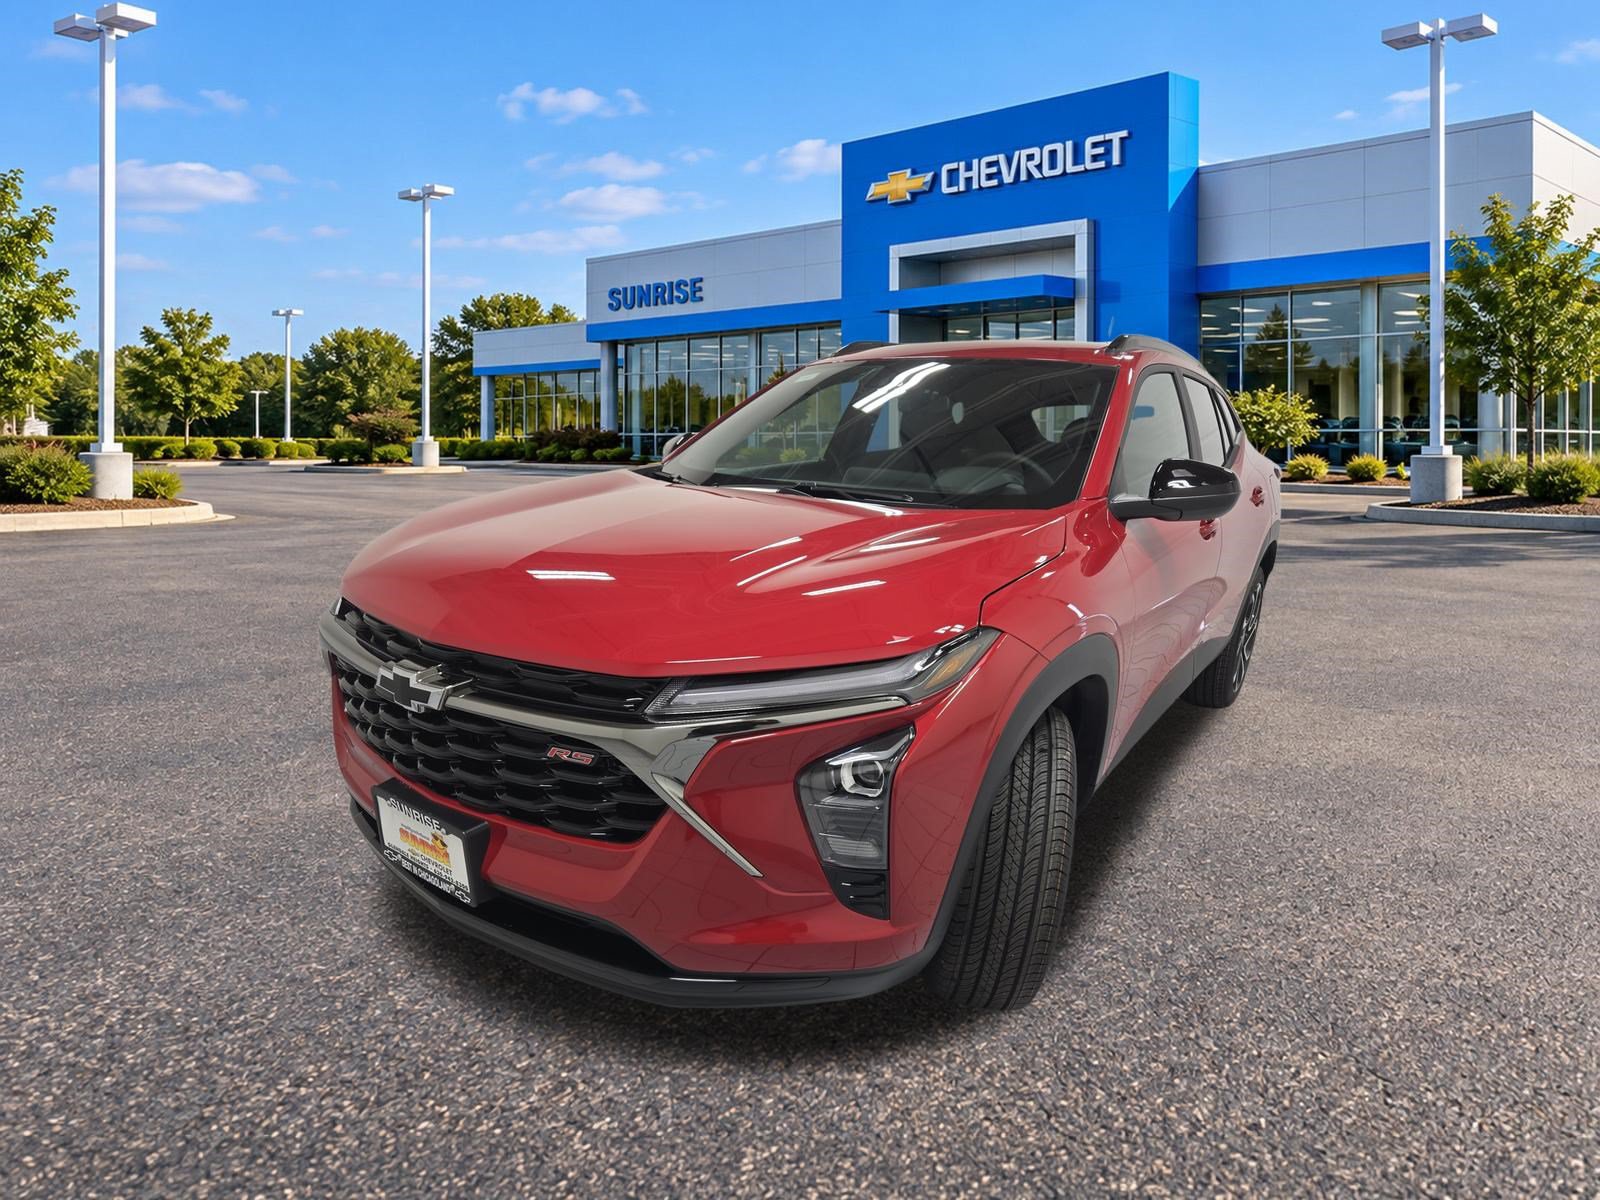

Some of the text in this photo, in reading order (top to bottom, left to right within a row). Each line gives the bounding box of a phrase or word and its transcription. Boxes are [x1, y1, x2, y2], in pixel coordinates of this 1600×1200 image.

[941, 130, 1128, 194] CHEVROLET
[608, 277, 704, 311] SUNRISE
[547, 747, 594, 765] RS
[390, 797, 441, 831] SUNRISE
[401, 859, 412, 872] BEST
[420, 853, 452, 876] CHEVROLET
